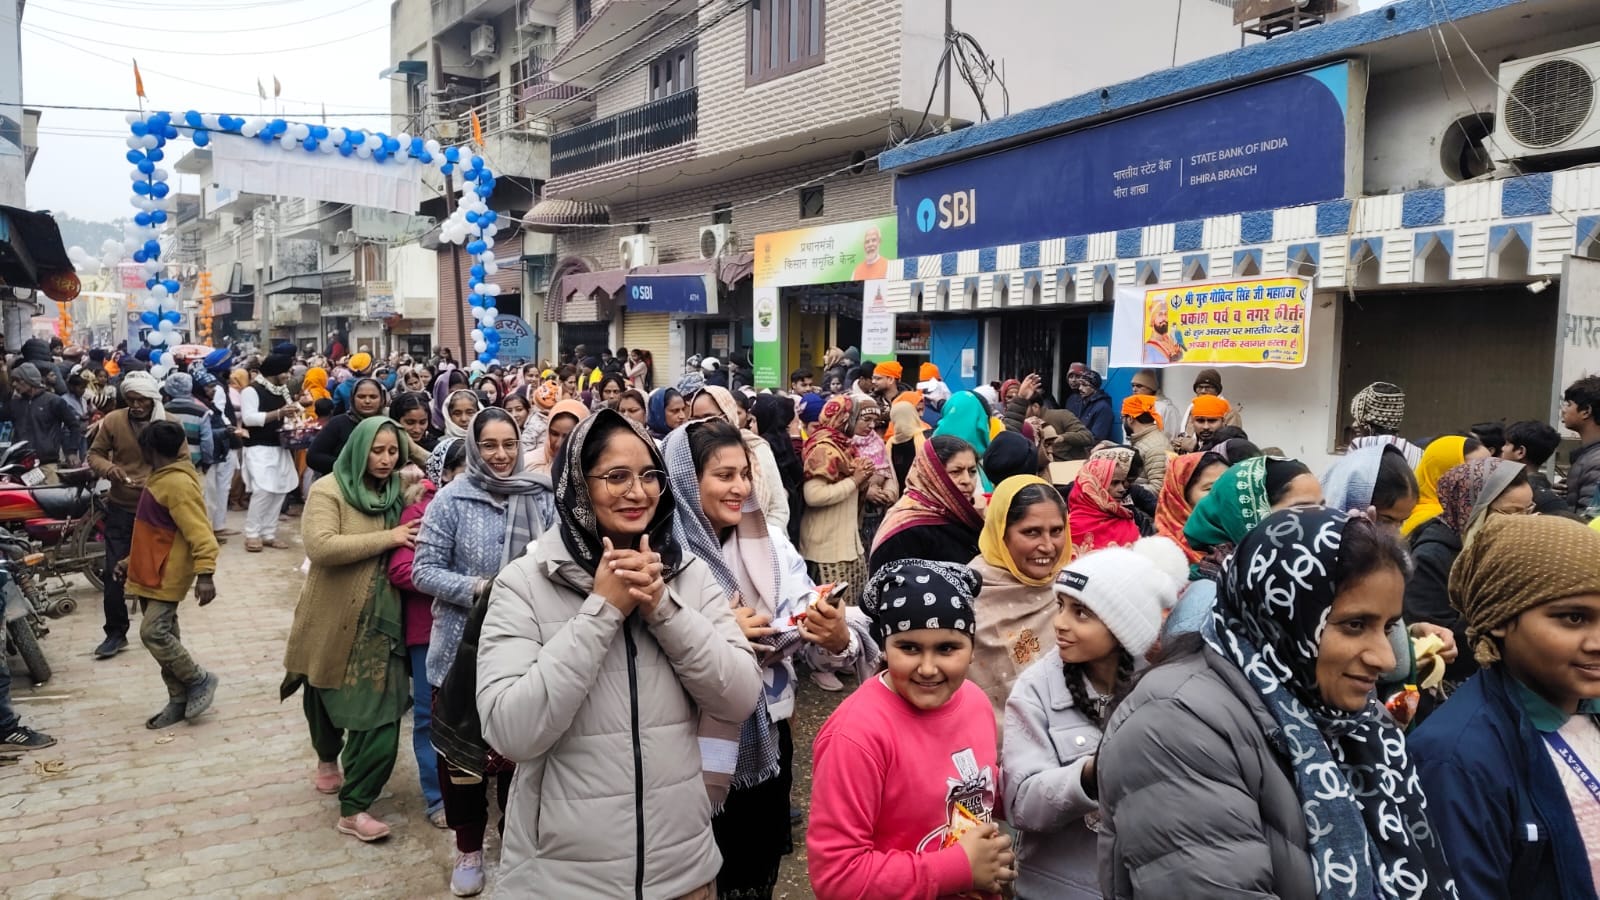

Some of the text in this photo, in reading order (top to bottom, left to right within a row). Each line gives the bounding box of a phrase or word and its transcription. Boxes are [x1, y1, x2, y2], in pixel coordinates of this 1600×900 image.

[1190, 137, 1288, 166] STATE BANK OF INDIA
[1113, 164, 1139, 181] भारतीय
[1140, 161, 1157, 178] स्टेट
[1190, 165, 1257, 186] BHIRA BRANCH
[1113, 183, 1149, 199] भीरा शाखा
[938, 188, 976, 230] SBI
[800, 236, 834, 253] प्रधानमंत्री
[784, 257, 808, 271] किसान
[639, 285, 653, 300] SBI
[689, 293, 699, 301] ATM
[1185, 290, 1194, 308] श्री
[1210, 288, 1233, 304] गोविन्द
[1236, 285, 1250, 303] सिंह
[1253, 285, 1263, 300] जी
[1180, 311, 1208, 326] प्रकाश
[1233, 309, 1241, 323] व
[1246, 307, 1270, 323] नगर
[1205, 327, 1230, 337] अवसर
[1232, 326, 1243, 336] पर
[1558, 747, 1590, 782] BEAT
